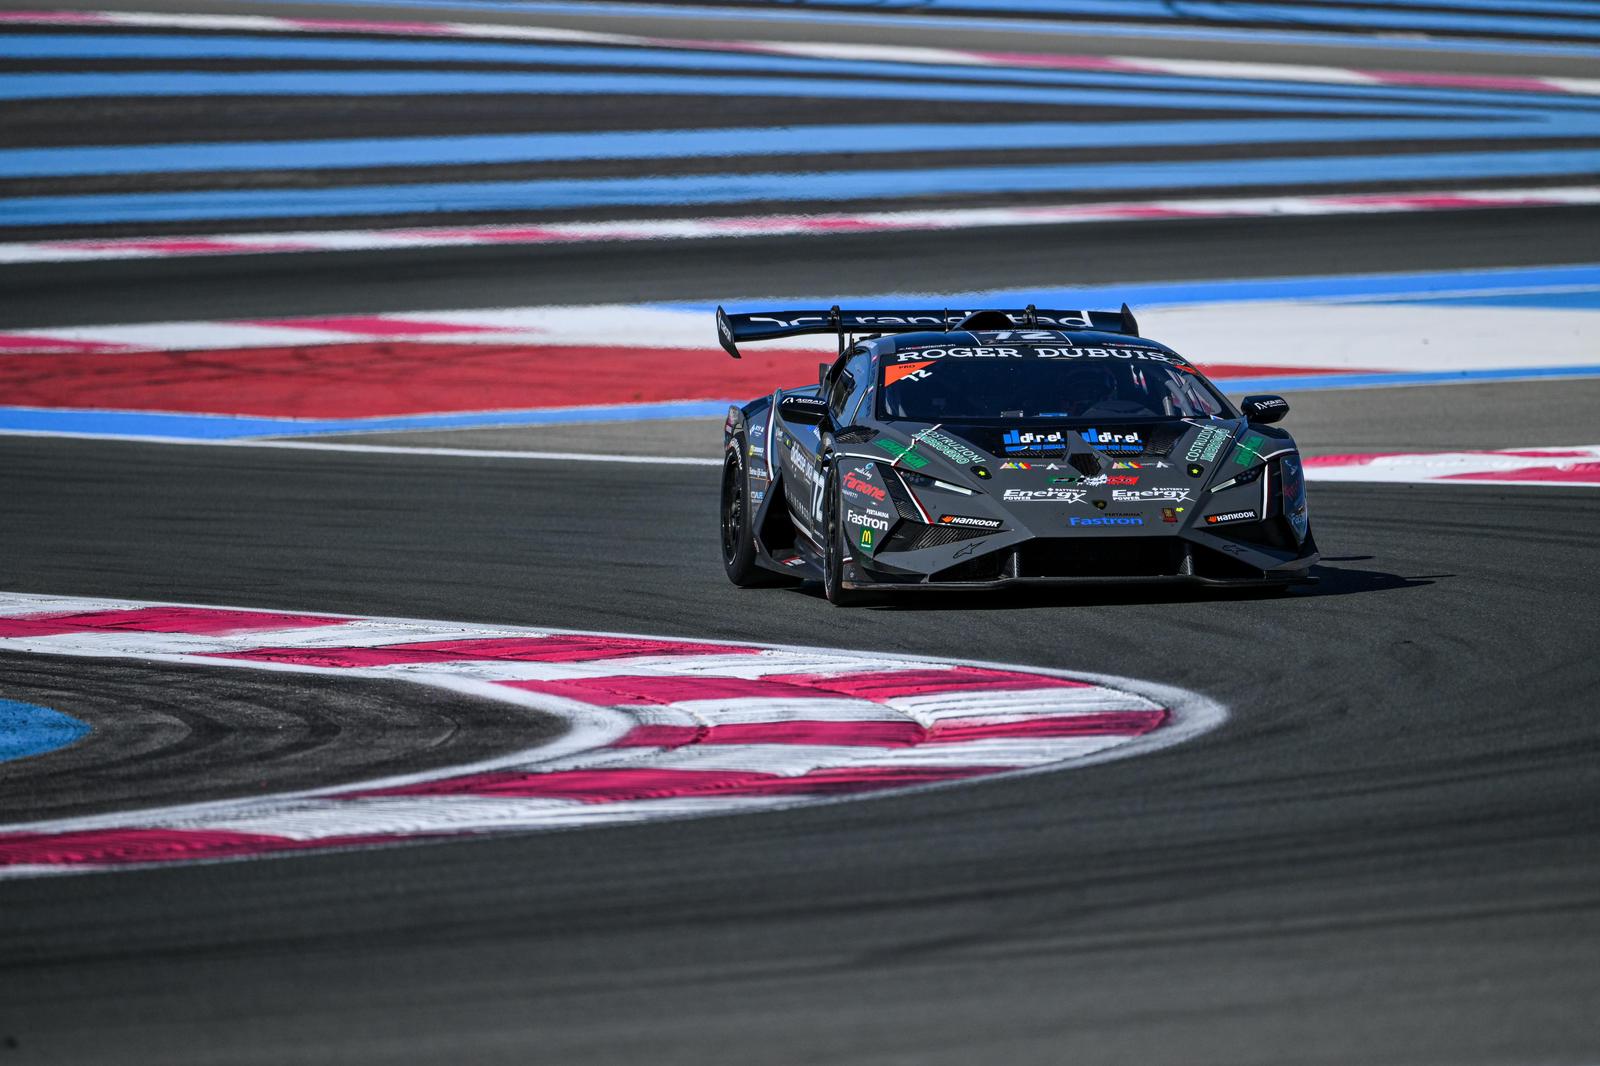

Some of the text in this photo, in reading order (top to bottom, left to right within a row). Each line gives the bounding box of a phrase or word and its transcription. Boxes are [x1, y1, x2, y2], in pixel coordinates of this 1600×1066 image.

[855, 311, 1094, 328] randtad
[896, 347, 1169, 361] ROGER DUBUIS
[900, 369, 933, 382] 72
[842, 472, 886, 501] faraone
[811, 469, 825, 522] 72
[1003, 489, 1087, 501] Energy
[1112, 489, 1190, 500] Energy
[847, 509, 889, 531] Fastron
[1068, 517, 1143, 526] Fastron
